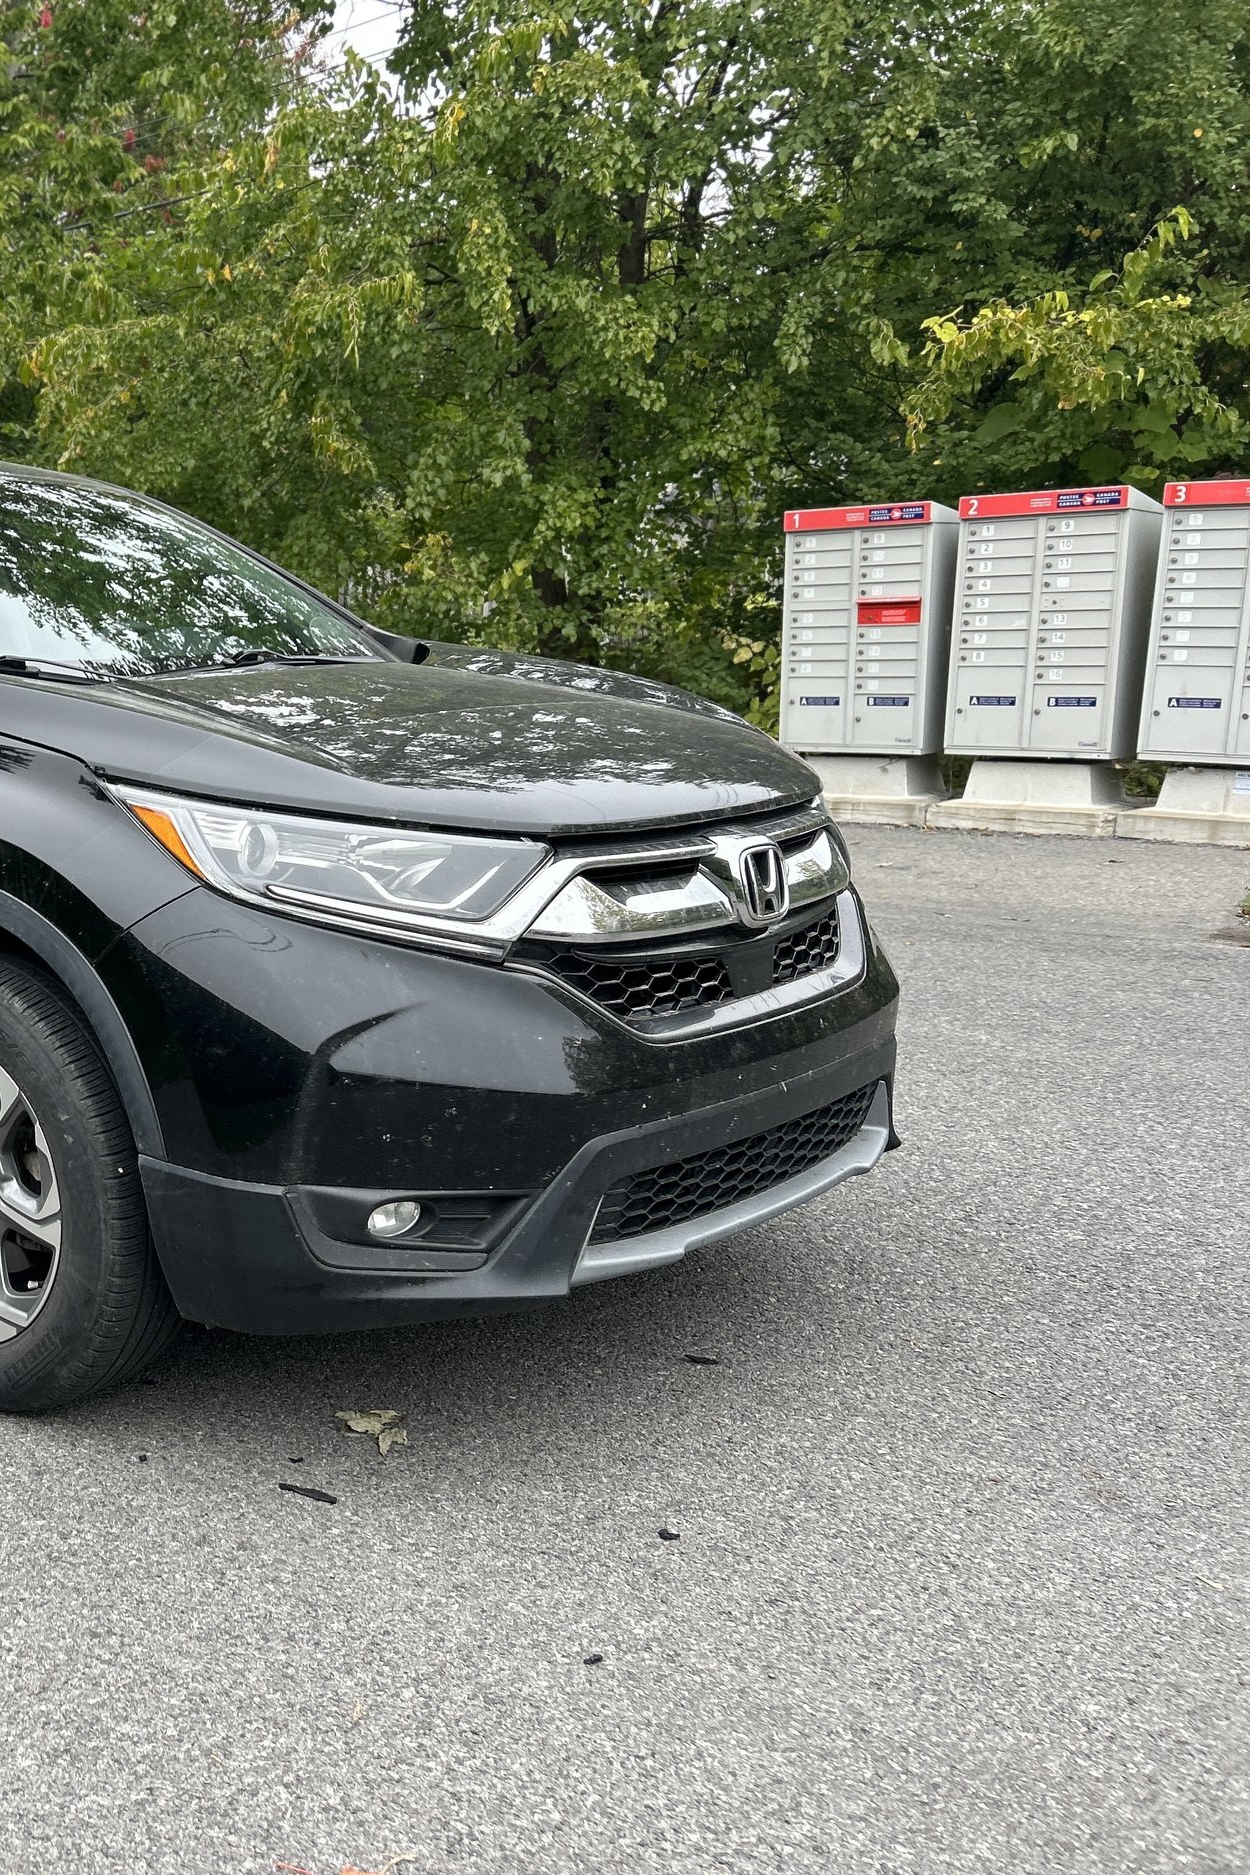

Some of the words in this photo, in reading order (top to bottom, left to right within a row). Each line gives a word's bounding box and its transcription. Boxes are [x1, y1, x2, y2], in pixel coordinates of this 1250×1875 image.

[1174, 486, 1186, 502] 3
[968, 500, 978, 514] 2
[792, 514, 800, 528] 1
